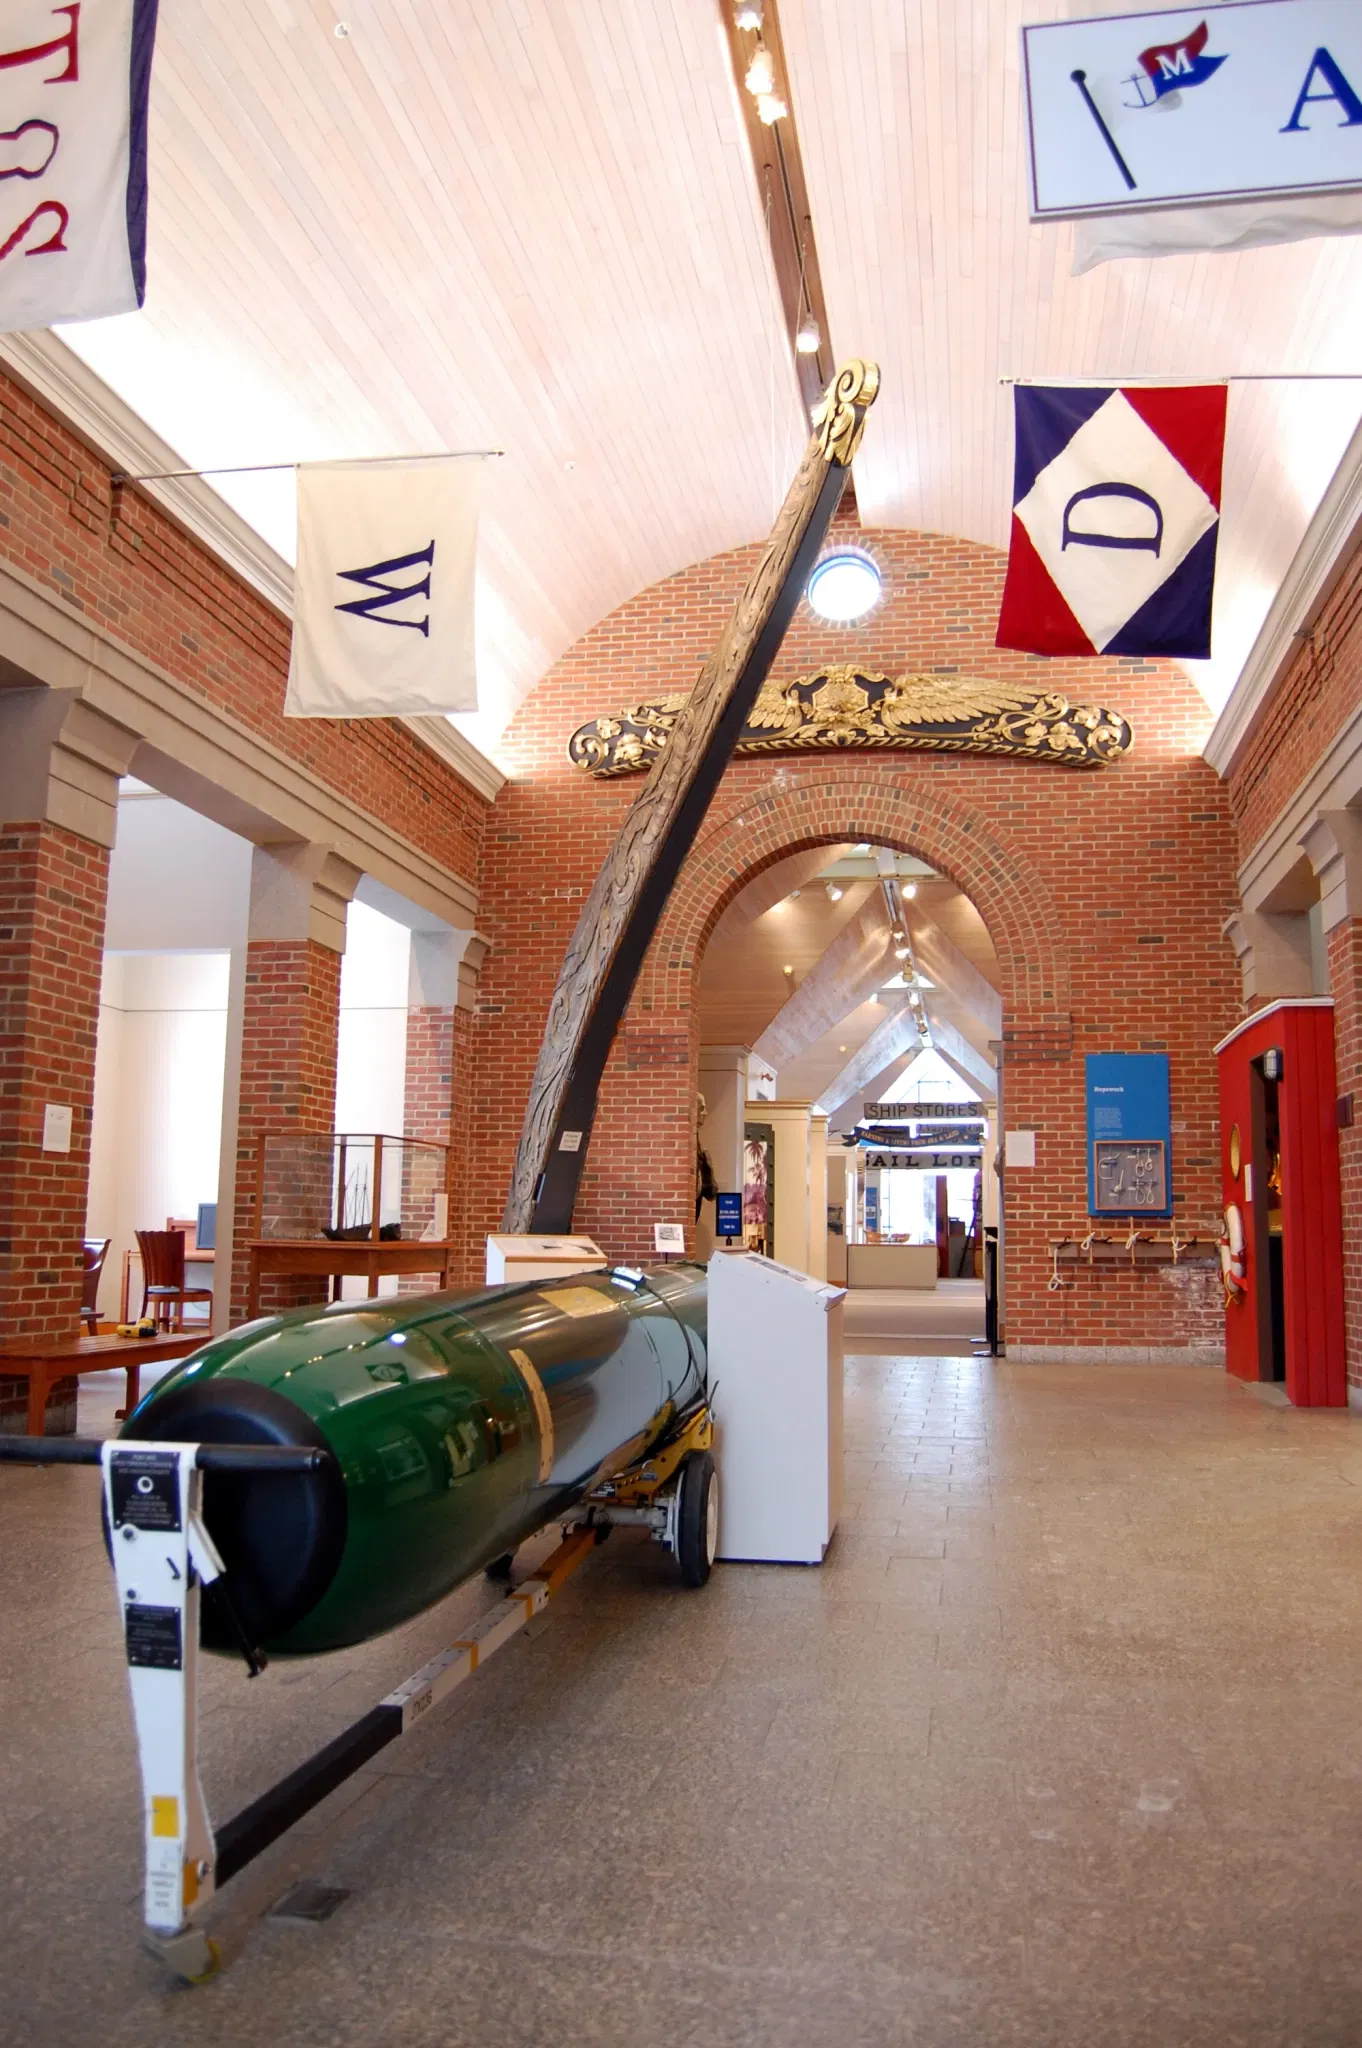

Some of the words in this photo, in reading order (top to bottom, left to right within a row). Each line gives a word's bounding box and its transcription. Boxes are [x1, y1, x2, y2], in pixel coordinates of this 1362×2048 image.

[1155, 47, 1195, 80] M
[1061, 481, 1164, 560] D
[334, 539, 435, 638] W
[869, 1104, 908, 1118] SHIP
[913, 1104, 978, 1117] STORES
